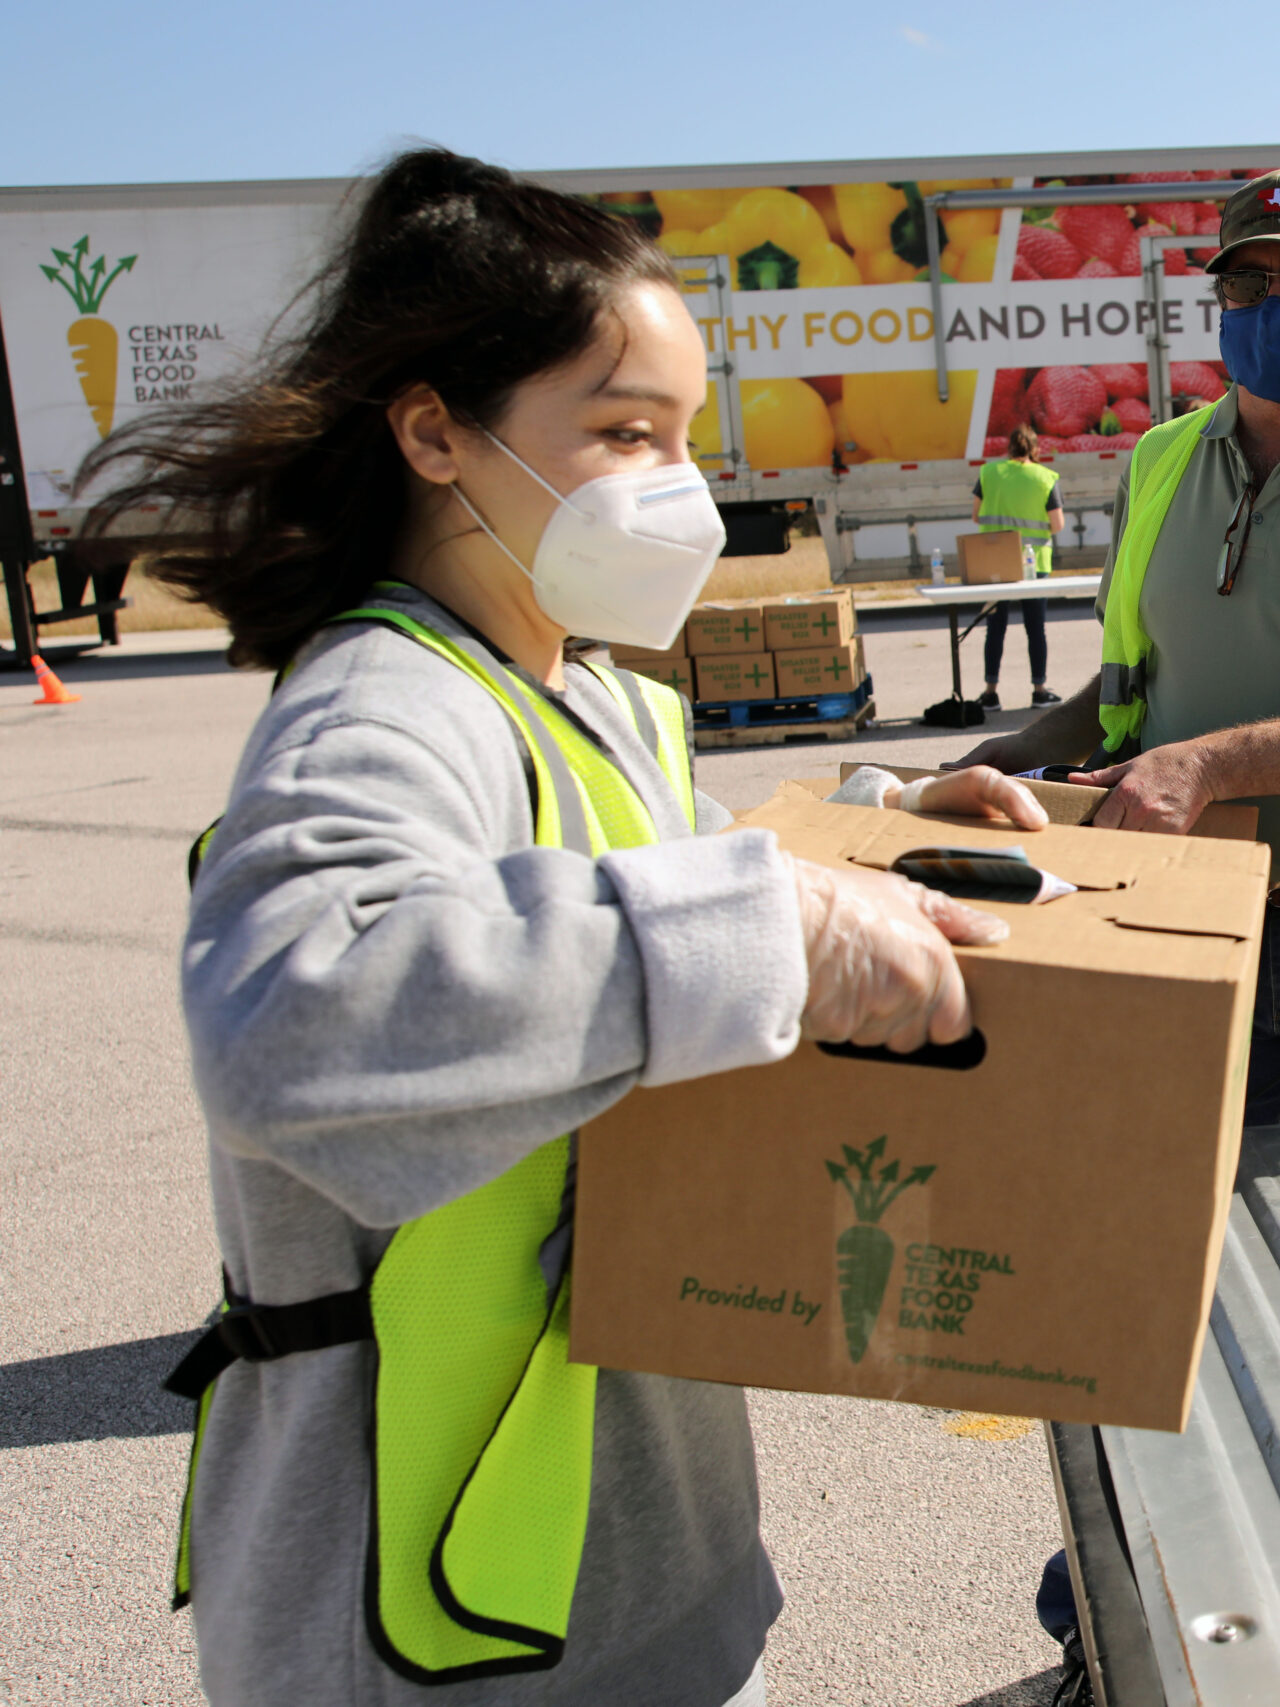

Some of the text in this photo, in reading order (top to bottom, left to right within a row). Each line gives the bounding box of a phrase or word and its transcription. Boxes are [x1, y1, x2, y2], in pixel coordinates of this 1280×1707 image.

[128, 323, 225, 343] CENTRAL
[697, 313, 788, 352] THY
[803, 307, 935, 348] FOOD
[945, 305, 1046, 342] AND
[1061, 300, 1184, 337] HOPE
[1195, 298, 1219, 333] T
[130, 344, 198, 362] TEXAS
[132, 365, 196, 382] FOOD
[134, 383, 193, 403] BANK
[904, 1243, 1016, 1275] CENTRAL
[904, 1263, 981, 1292] TEXAS
[679, 1276, 823, 1327] Provided by
[901, 1286, 974, 1313] FOOD
[898, 1308, 966, 1336] BANK
